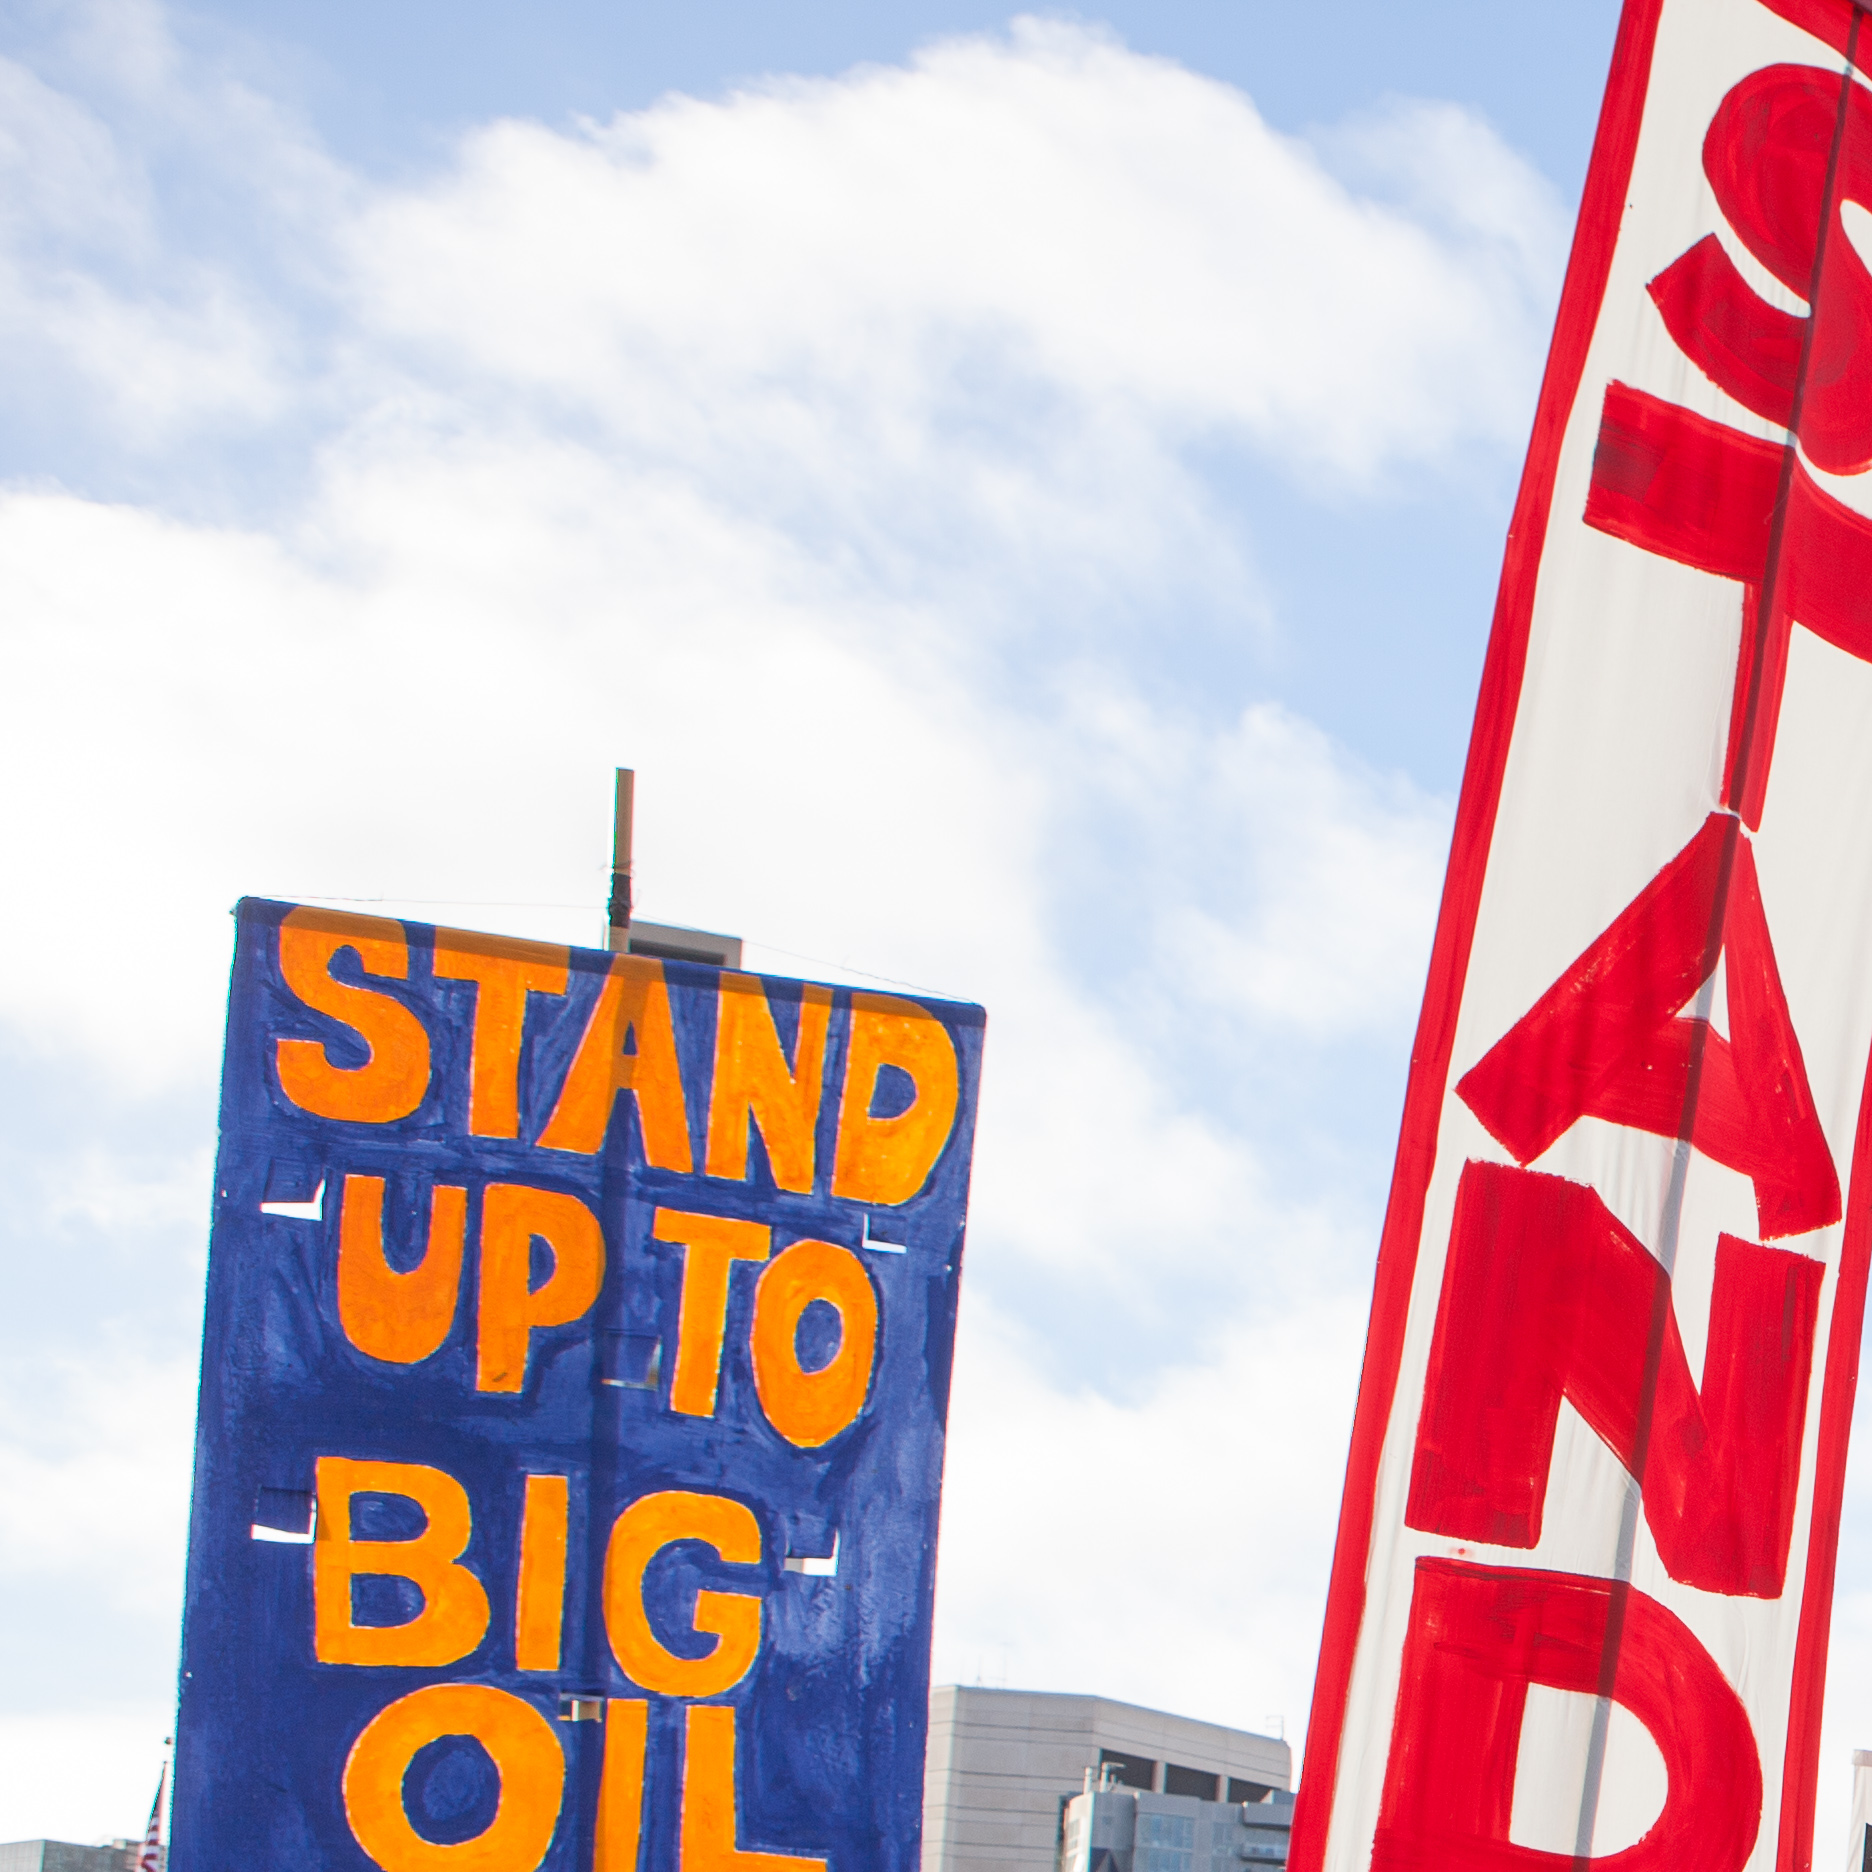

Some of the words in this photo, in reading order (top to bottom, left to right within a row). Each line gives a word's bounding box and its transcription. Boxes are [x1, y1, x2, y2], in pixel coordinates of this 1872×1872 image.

[274, 904, 960, 1206] STAND
[337, 1173, 606, 1394] UP
[653, 1206, 880, 1450] TO
[312, 1455, 762, 1698] BIG
